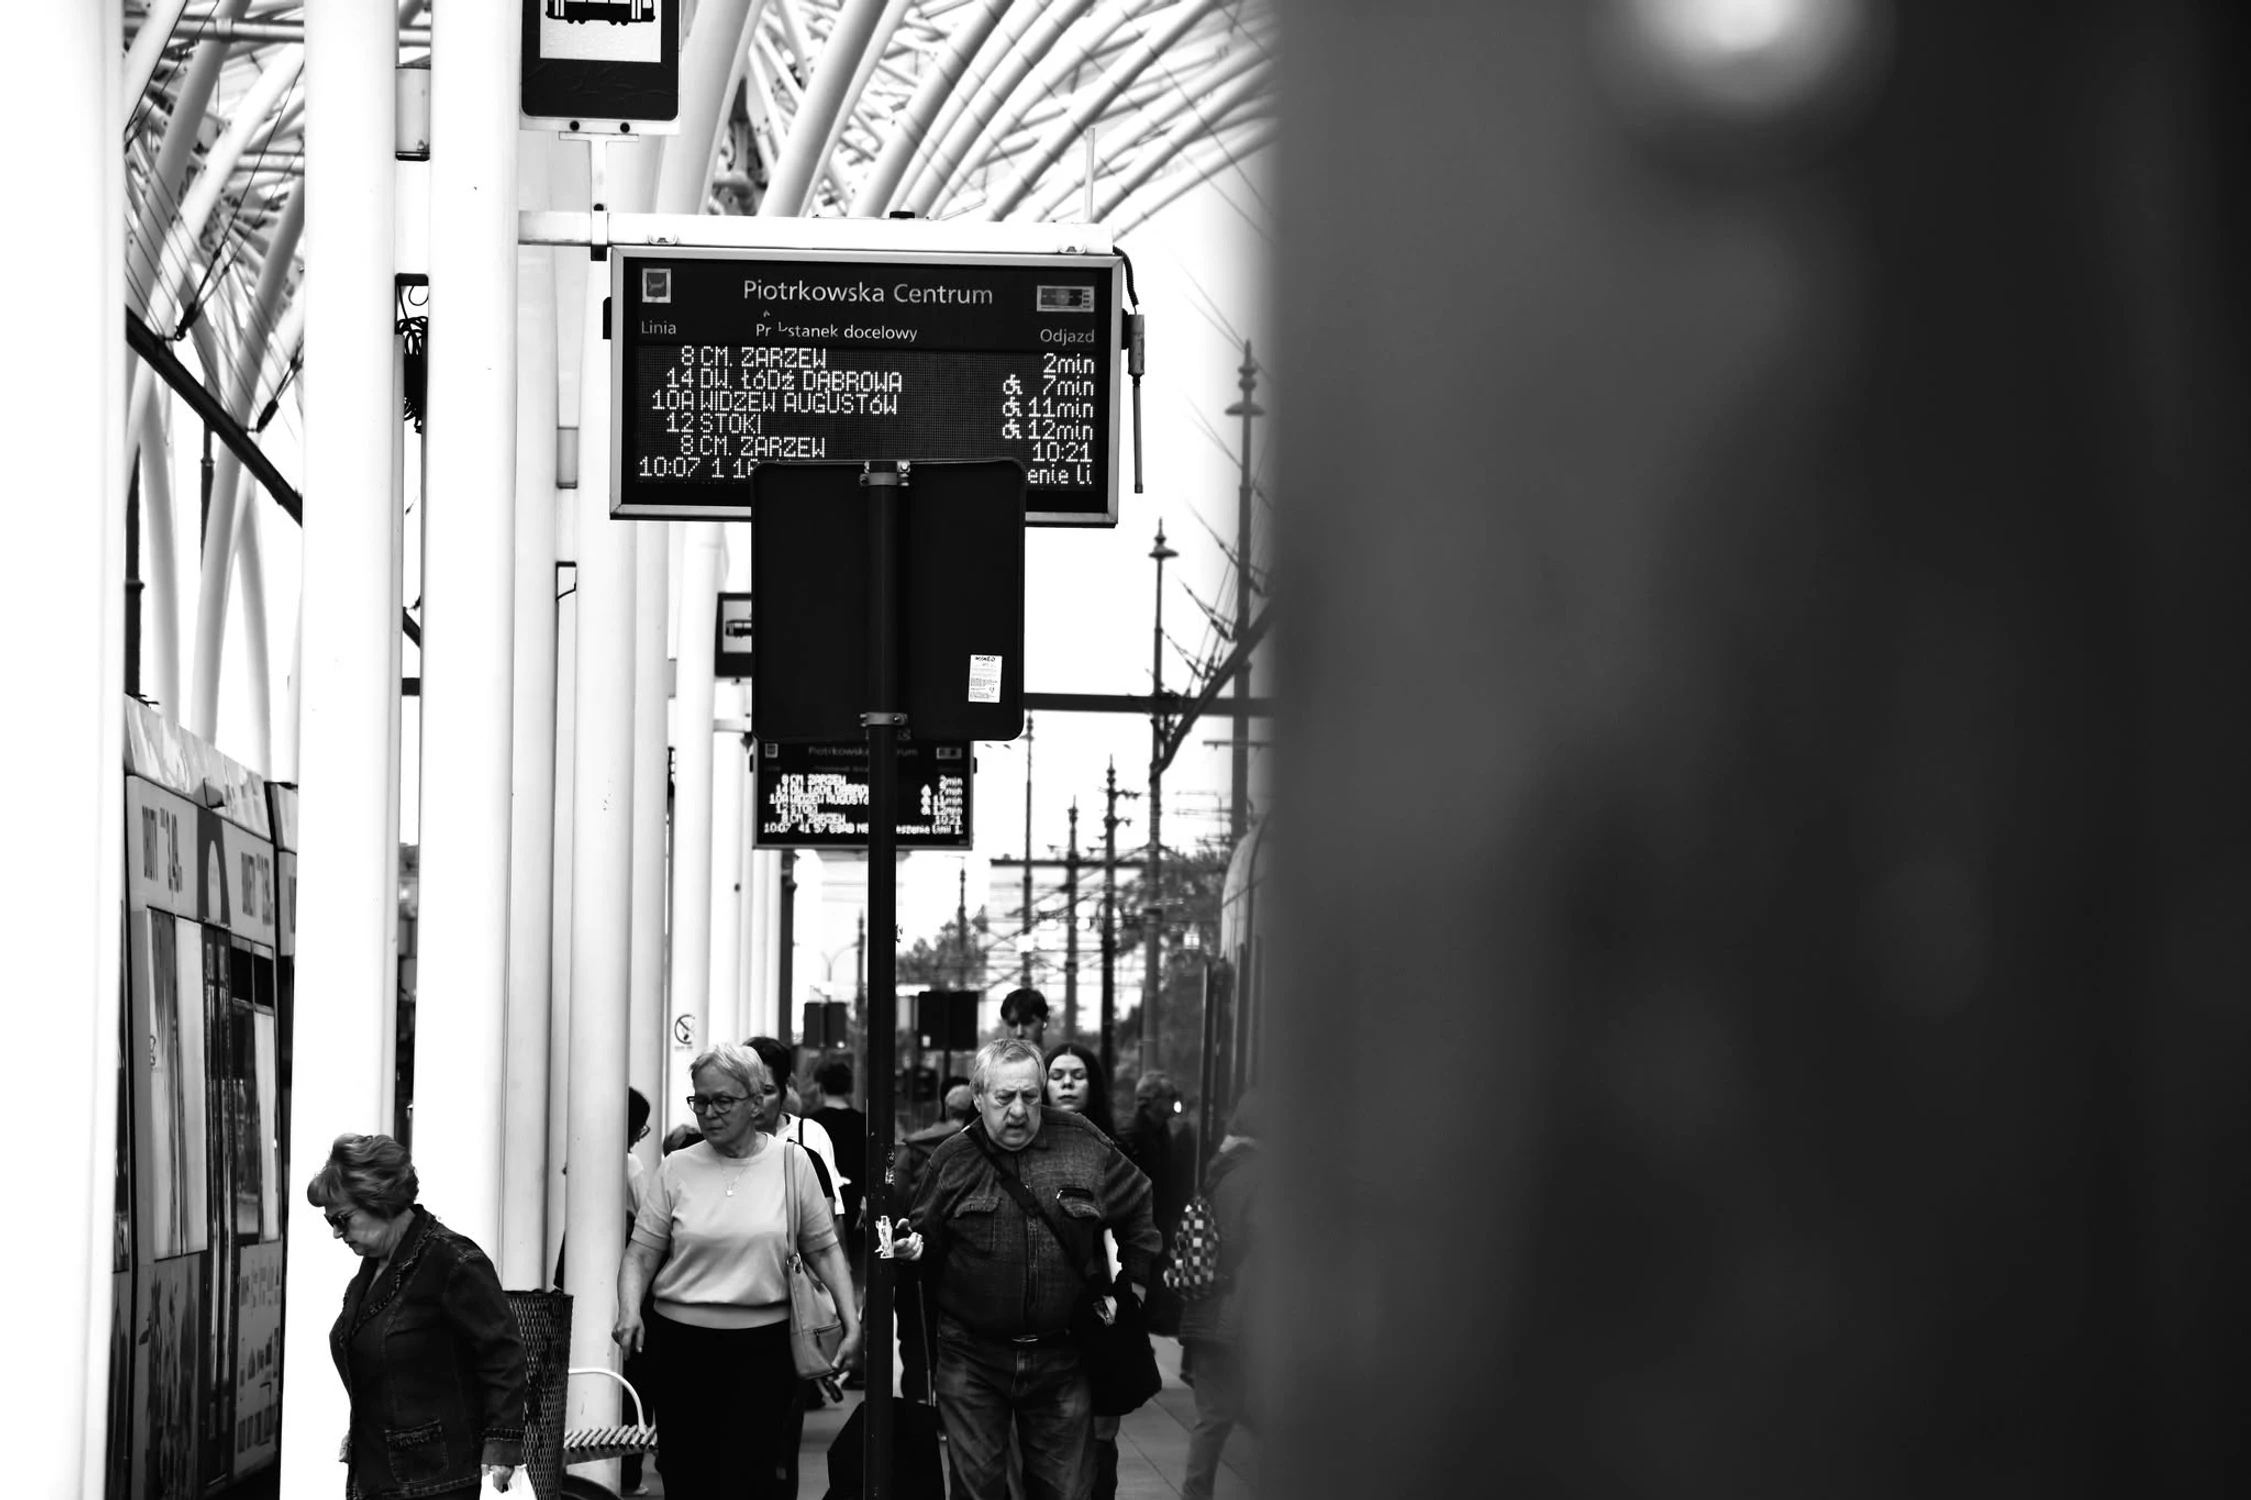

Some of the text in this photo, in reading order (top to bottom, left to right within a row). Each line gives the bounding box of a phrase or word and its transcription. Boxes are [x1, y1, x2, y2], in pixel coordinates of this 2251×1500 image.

[744, 279, 992, 304] Piotrkowska Centrum
[642, 320, 676, 334] Linia
[844, 324, 917, 342] docelowy
[1040, 329, 1094, 346] Odjazd
[682, 345, 826, 370] 8 CM. ZARZEW
[1043, 353, 1094, 374] 2min
[667, 367, 694, 388] 14
[1043, 375, 1094, 396] 7min
[653, 390, 694, 410] 10A
[700, 390, 776, 413] WIDZEW
[1029, 397, 1093, 418] 11min
[667, 412, 760, 434] 12 STOKI
[1028, 419, 1093, 440] 12min
[681, 435, 825, 457] 8 CM. ZARZEW
[1033, 441, 1092, 462] 10:21
[640, 456, 700, 477] 10:07
[712, 458, 724, 478] 1
